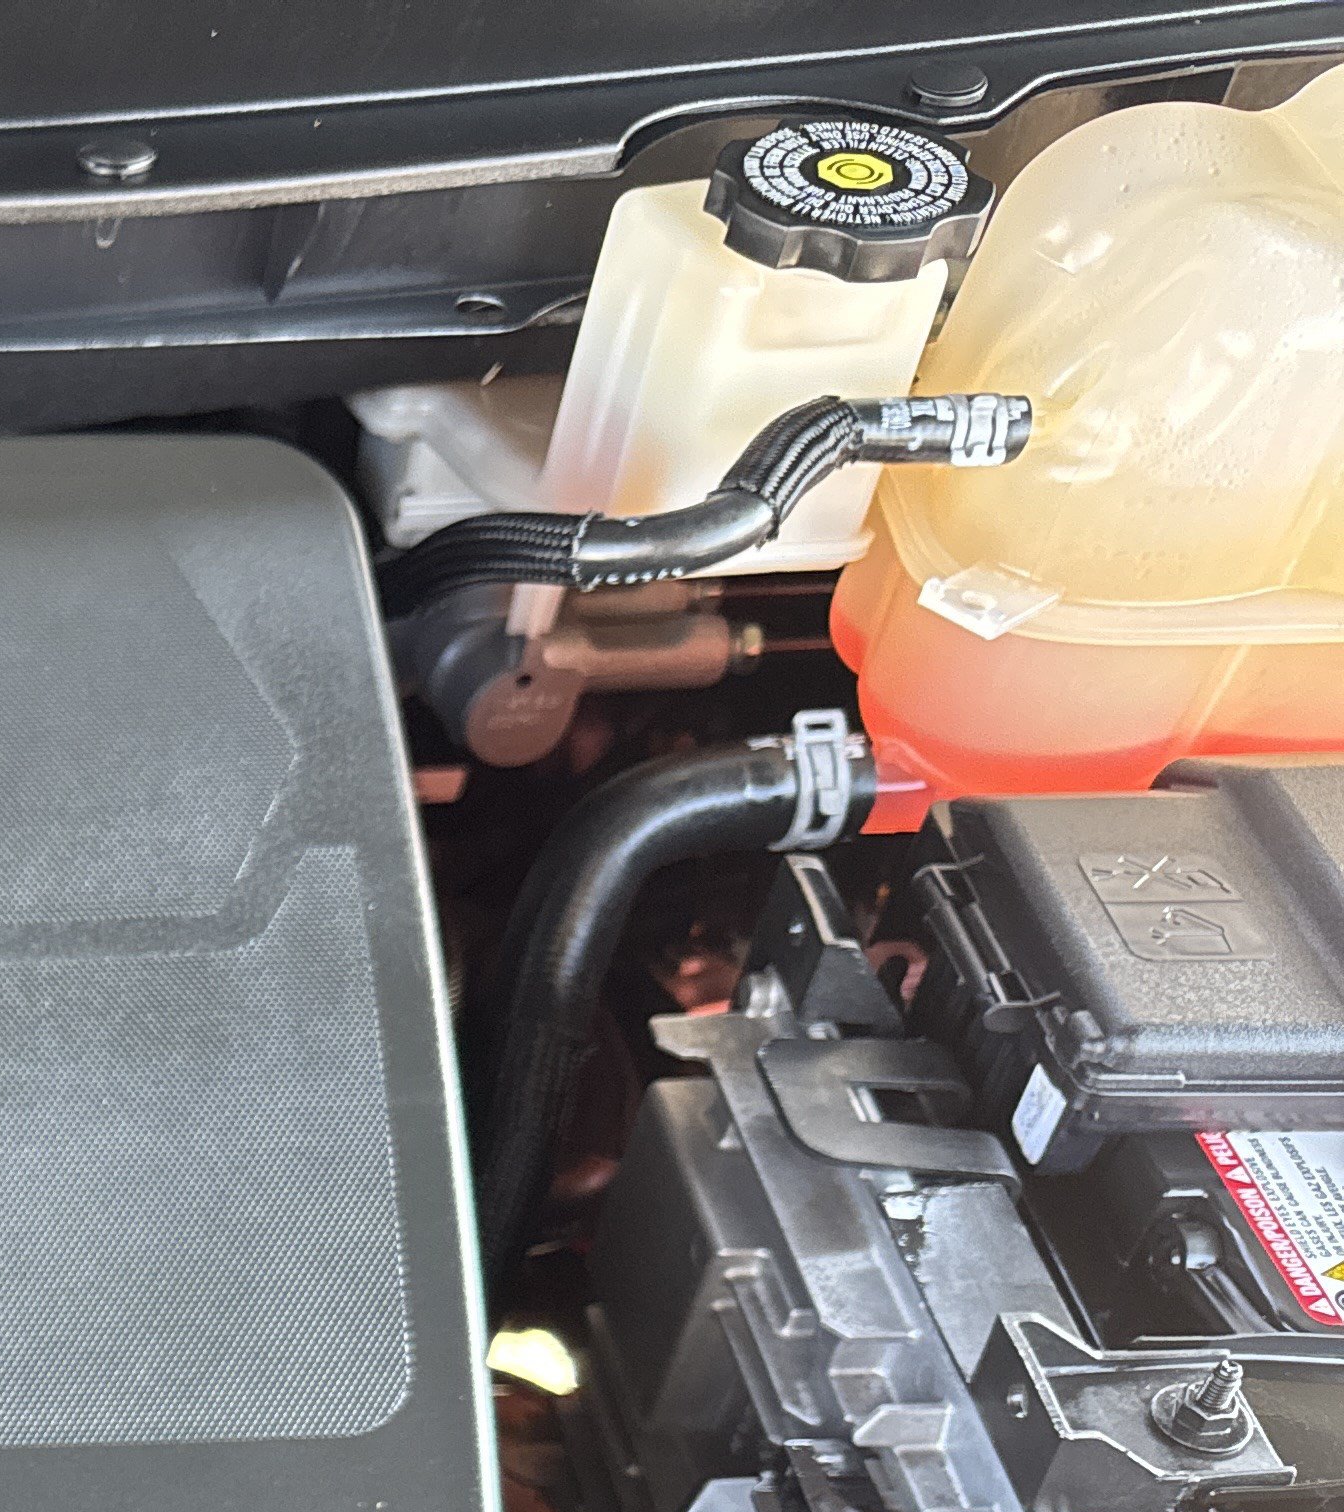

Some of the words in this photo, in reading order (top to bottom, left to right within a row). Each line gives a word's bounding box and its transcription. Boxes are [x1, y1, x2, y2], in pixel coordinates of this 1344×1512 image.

[846, 130, 868, 139] USE
[810, 209, 880, 222] NETTOYER
[828, 201, 853, 212] QUE
[1247, 1137, 1283, 1180] BLINDNESS
[1244, 1157, 1280, 1201] EXPLOSIVE
[1294, 1210, 1311, 1228] CAN
[1320, 1201, 1339, 1217] LES
[1236, 1187, 1322, 1296] DANGER/POISON
[1289, 1229, 1317, 1259] SHIELD
[1305, 1229, 1332, 1257] GASES
